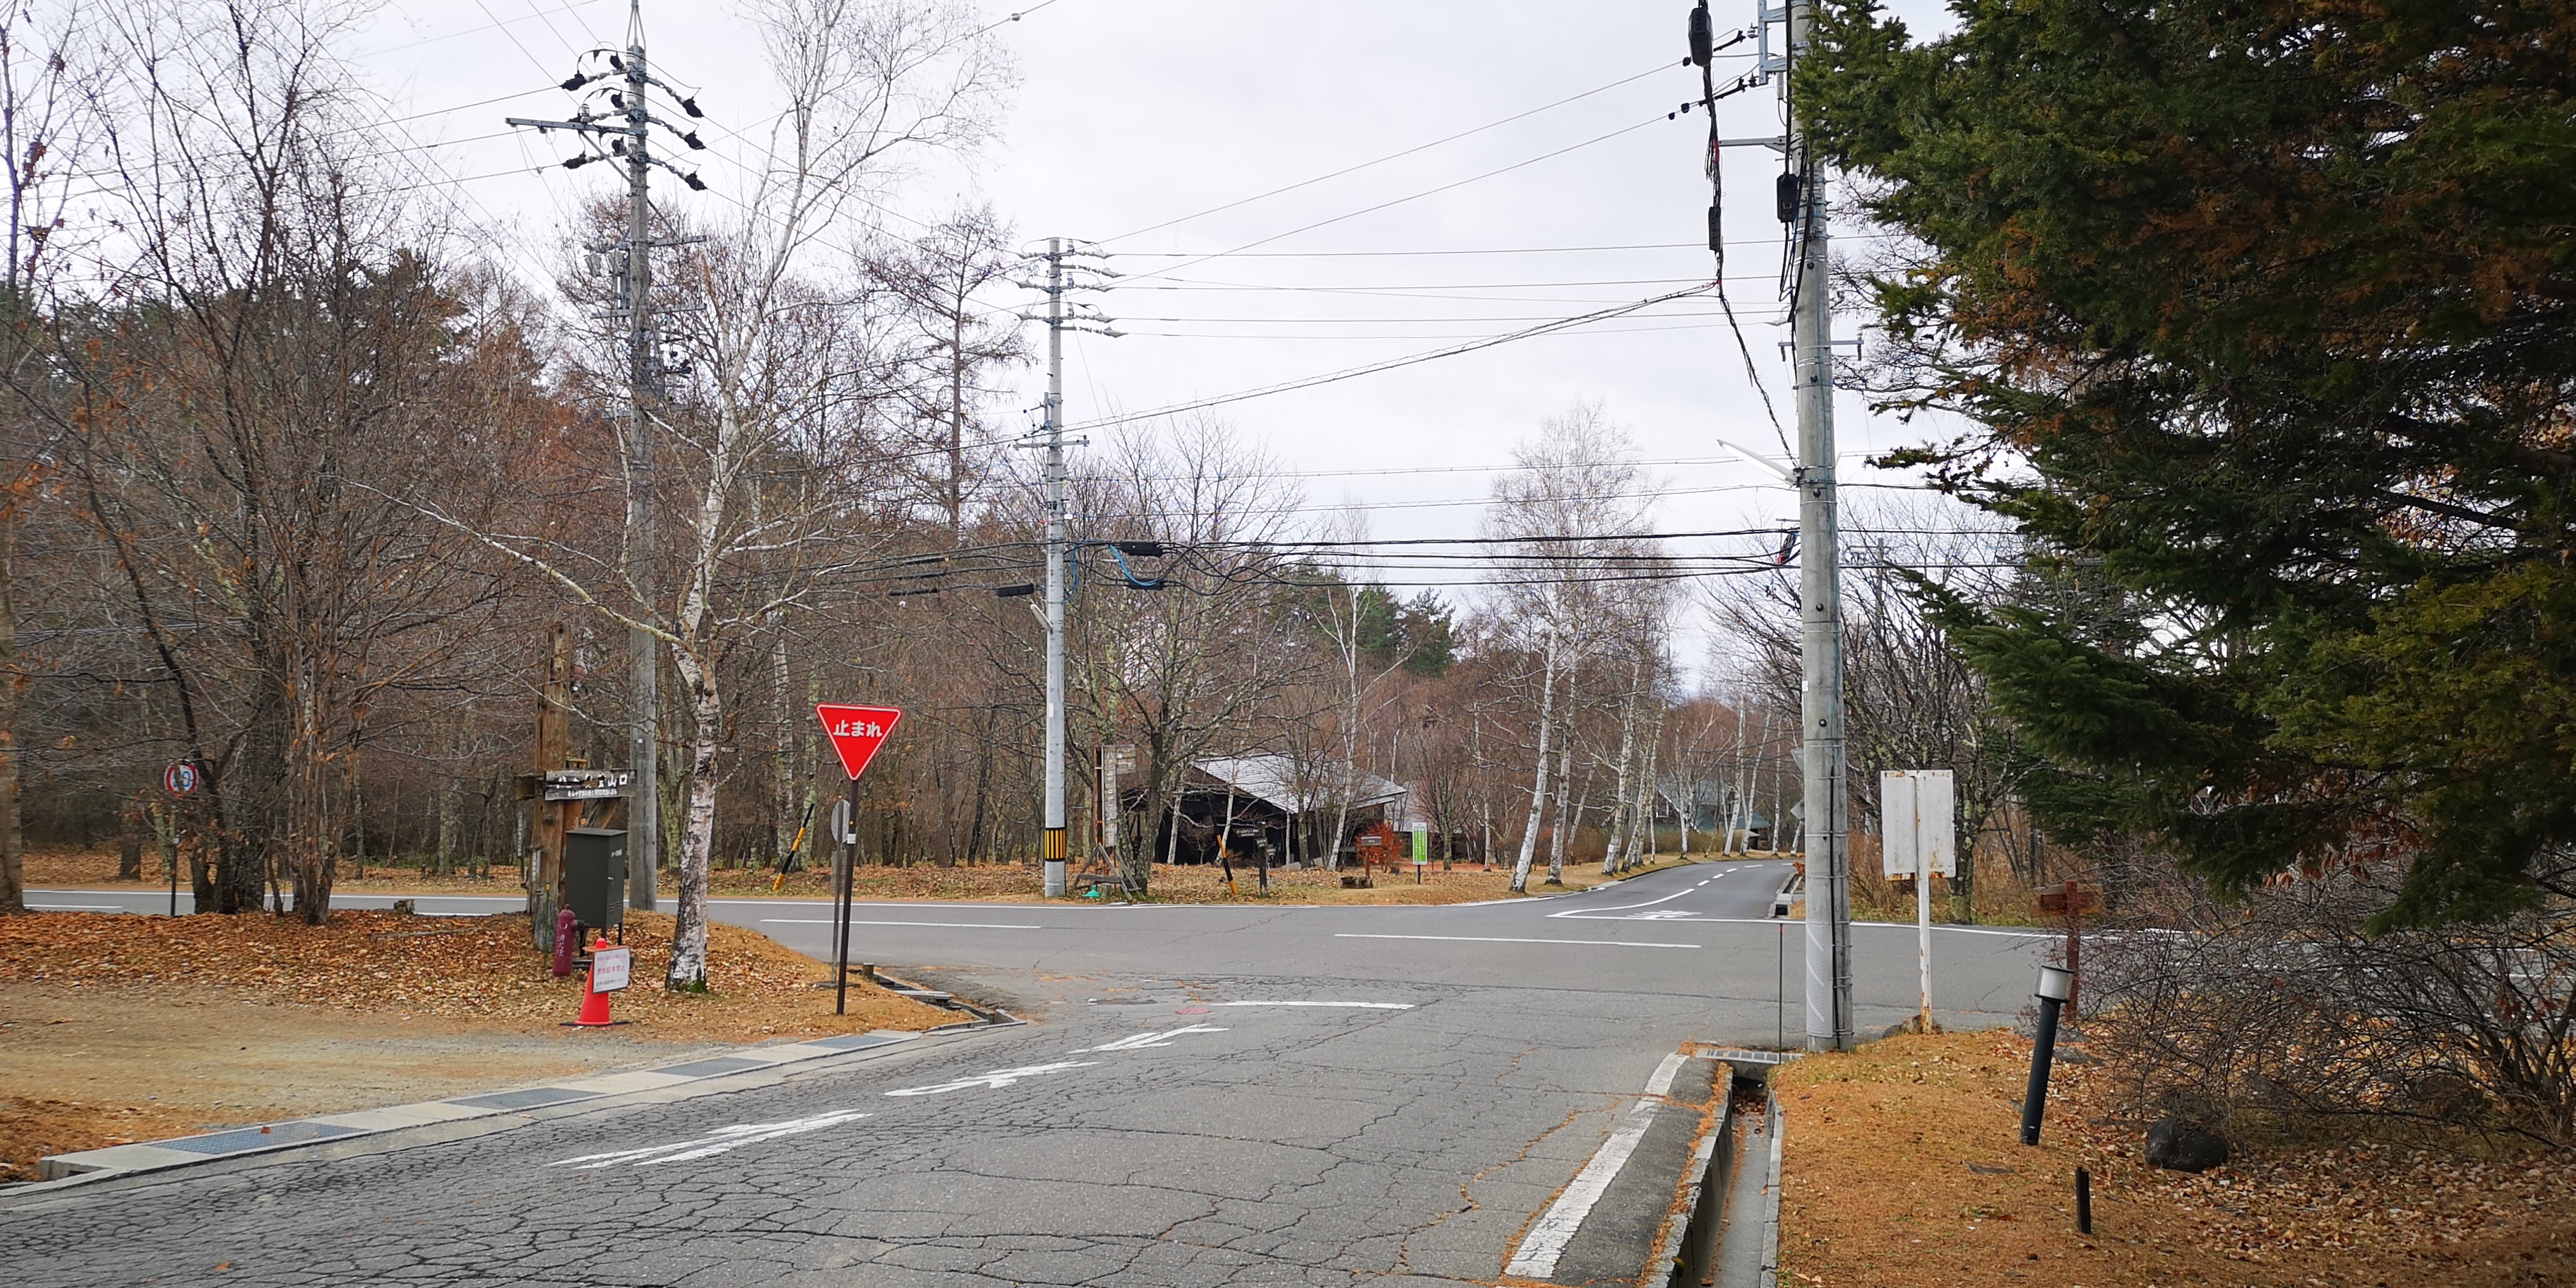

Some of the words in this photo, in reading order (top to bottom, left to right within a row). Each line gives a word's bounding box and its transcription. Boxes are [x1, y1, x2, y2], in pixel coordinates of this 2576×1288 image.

[833, 719, 883, 738] 止まれ
[556, 934, 566, 957] 消火栓
